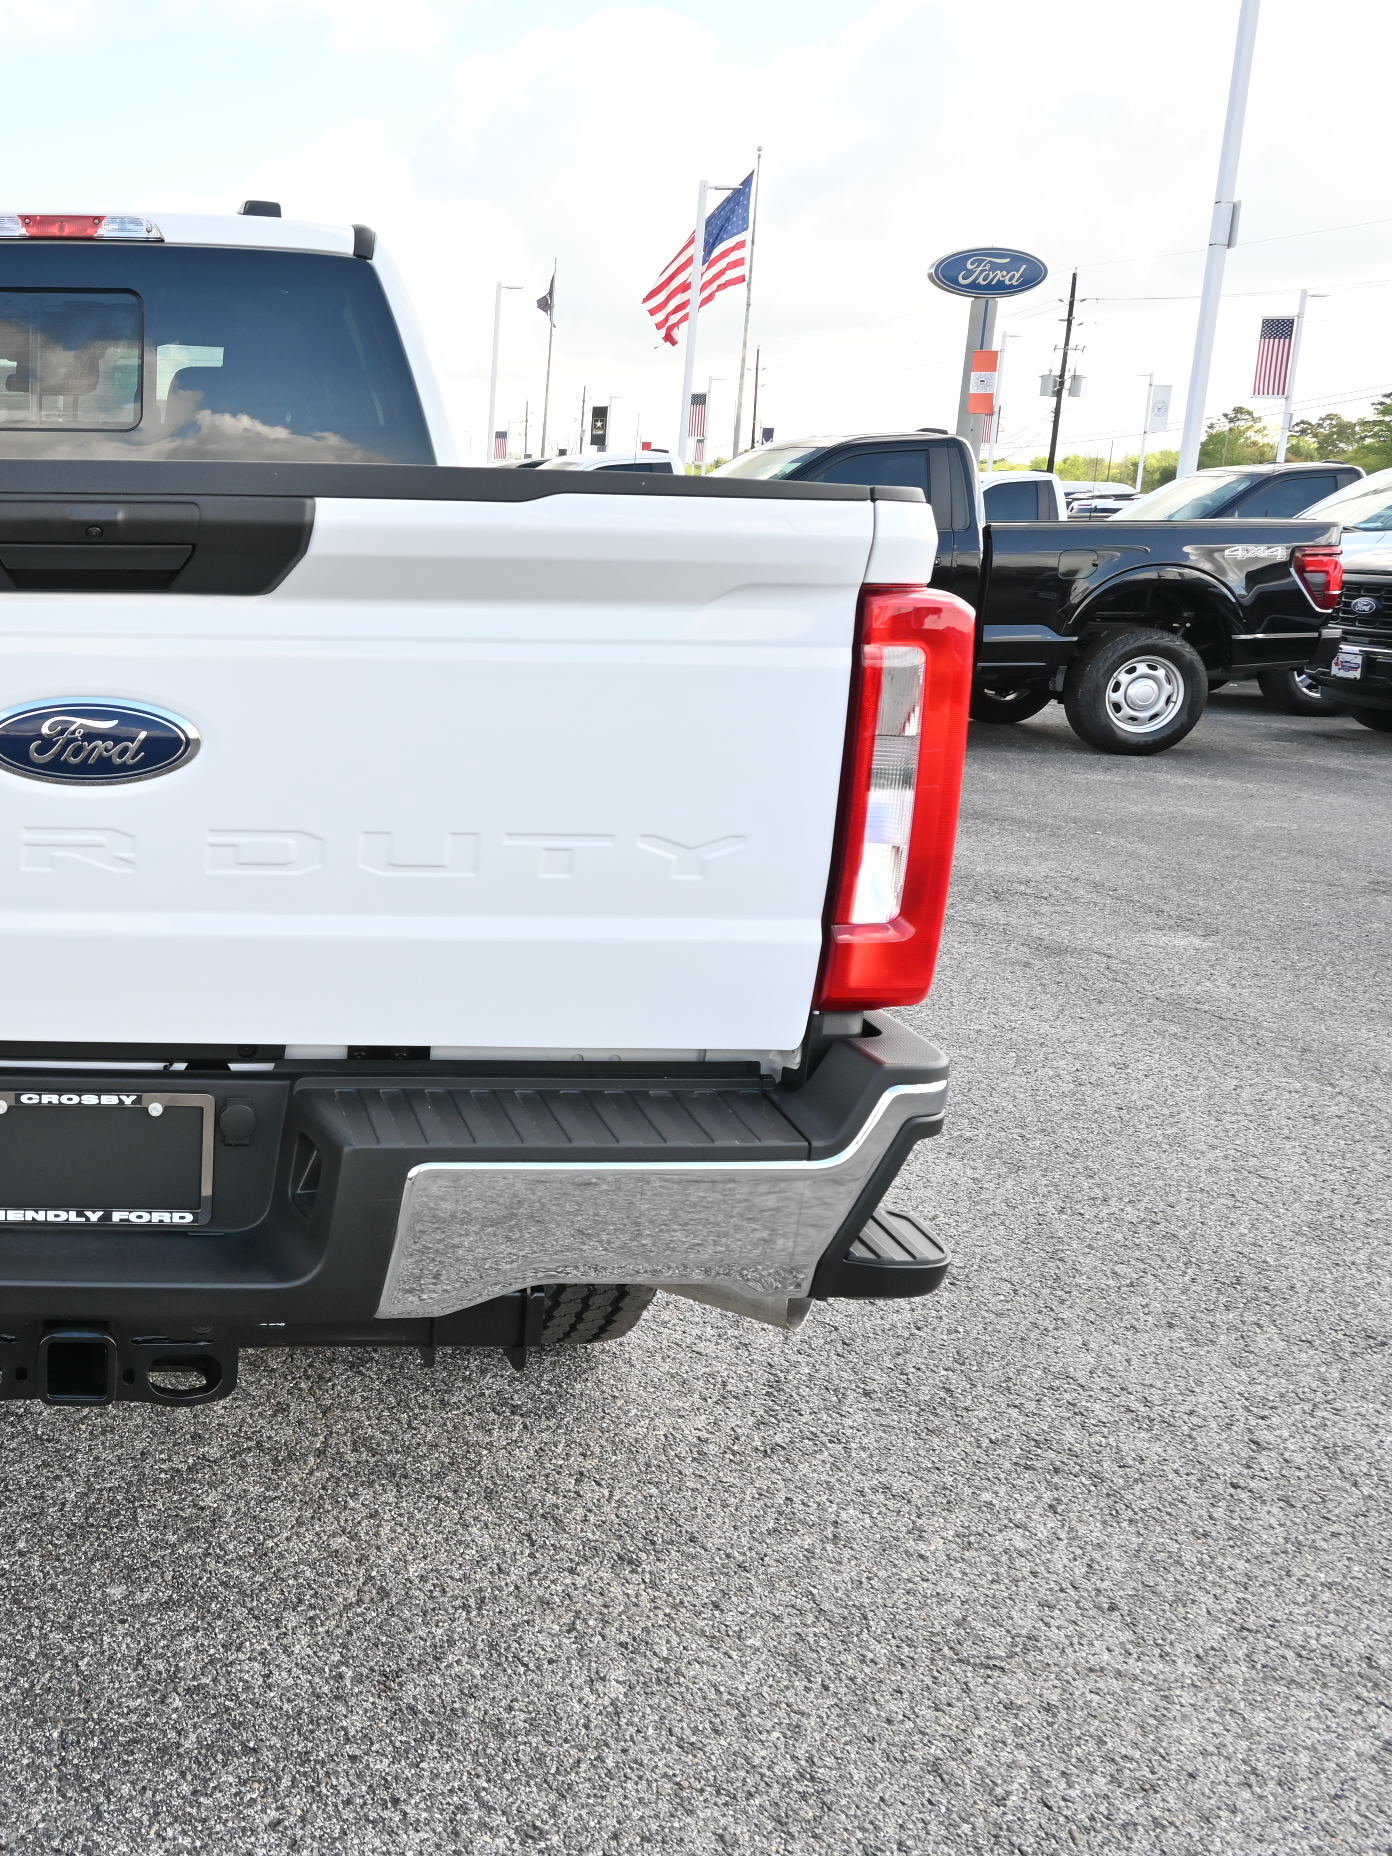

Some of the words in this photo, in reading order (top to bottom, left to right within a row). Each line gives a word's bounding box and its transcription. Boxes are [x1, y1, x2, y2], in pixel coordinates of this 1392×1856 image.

[958, 256, 1027, 285] Ford
[29, 715, 148, 765] Ford
[205, 828, 748, 880] DUTY
[20, 1093, 137, 1105] CROSBY
[112, 1211, 194, 1223] FORD
